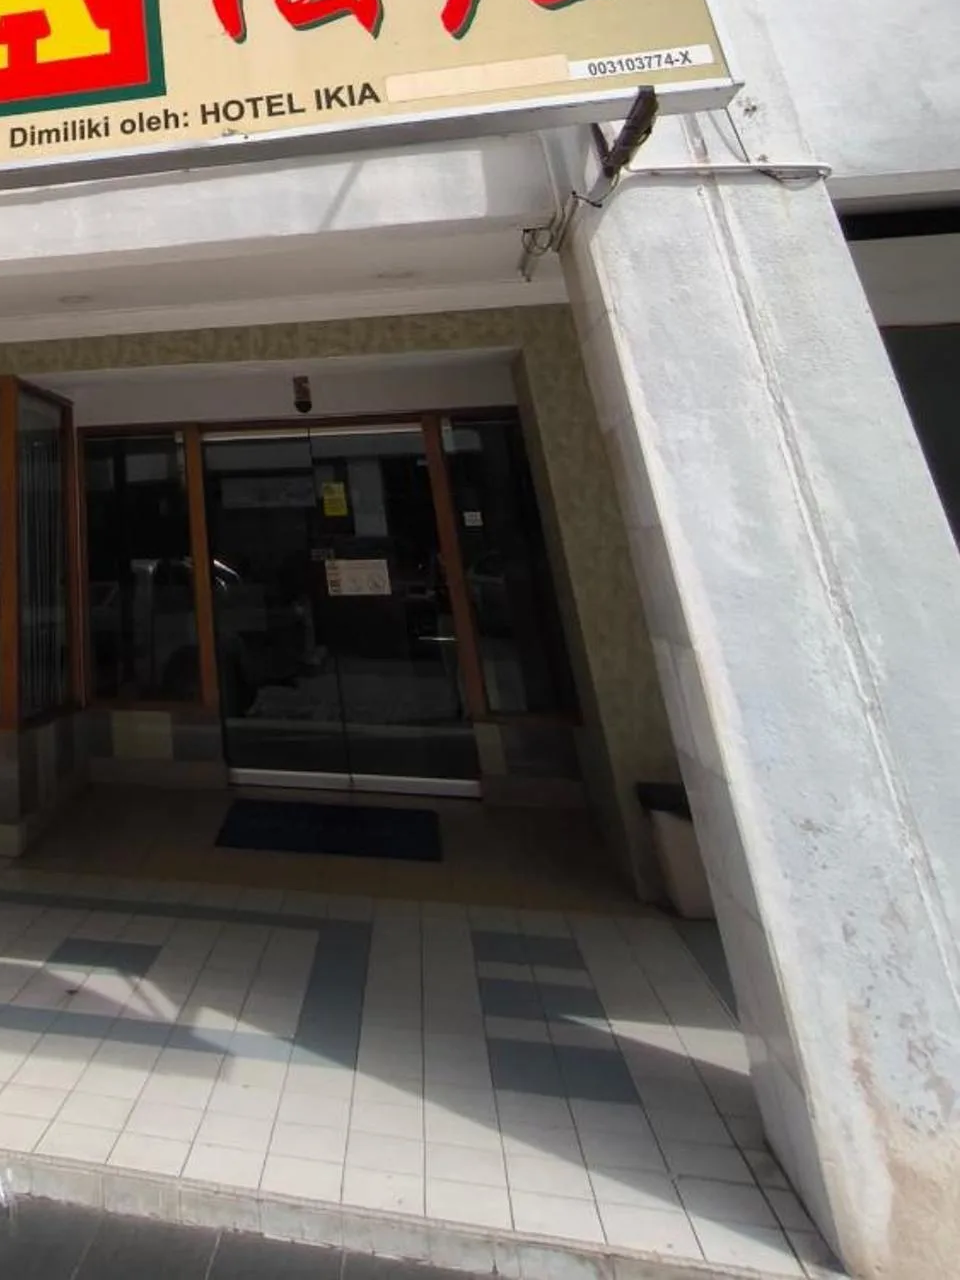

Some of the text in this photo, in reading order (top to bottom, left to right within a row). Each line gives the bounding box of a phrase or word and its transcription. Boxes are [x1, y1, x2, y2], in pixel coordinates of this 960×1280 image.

[587, 50, 692, 77] 003103774-X
[9, 82, 382, 148] Dimiliki oleh: HOTEL IKIA
